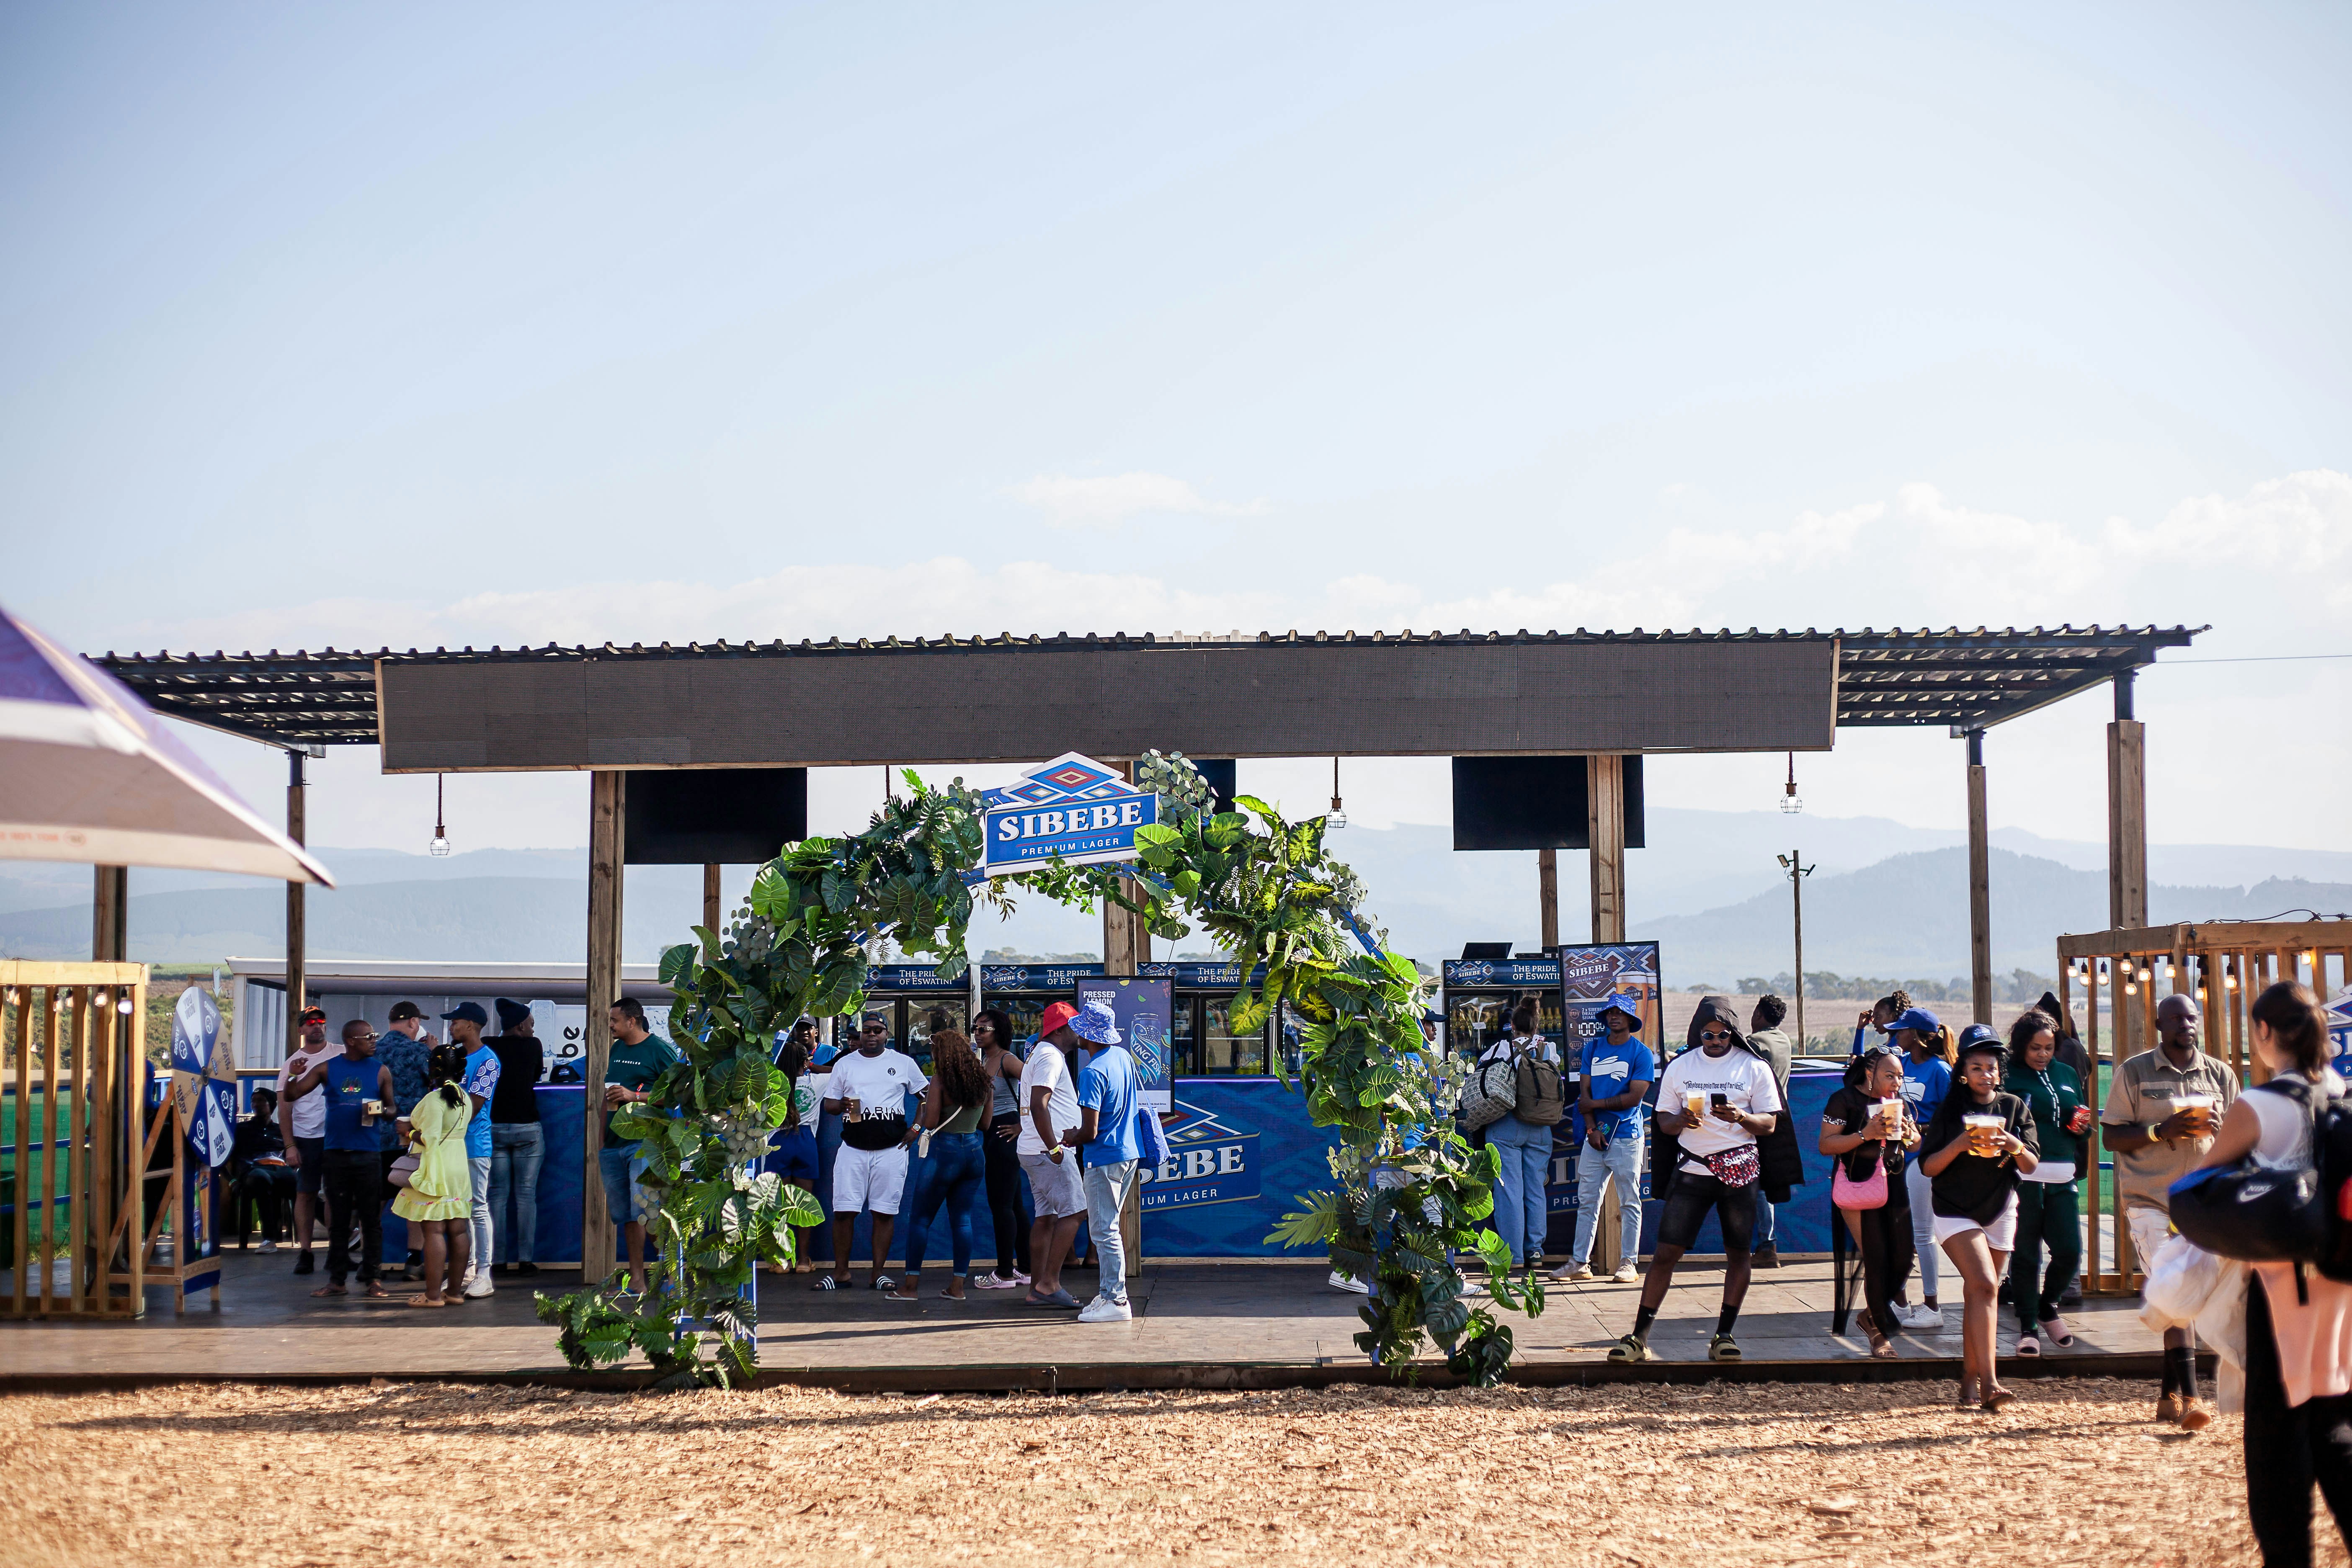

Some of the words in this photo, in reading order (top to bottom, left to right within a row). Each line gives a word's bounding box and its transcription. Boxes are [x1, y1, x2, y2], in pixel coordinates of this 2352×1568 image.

[998, 801, 1142, 841] SIBEBE
[1021, 843, 1075, 856] PREMIUM
[1083, 838, 1119, 849] LAGER
[1569, 963, 1609, 978] SIBEBE
[1131, 1034, 1151, 1060] FLYING
[1148, 1057, 1161, 1076] FISH
[843, 1112, 894, 1123] FAIANI
[214, 1132, 224, 1149] WIN
[216, 1142, 226, 1158] YOU
[1174, 1189, 1217, 1202] LAGER
